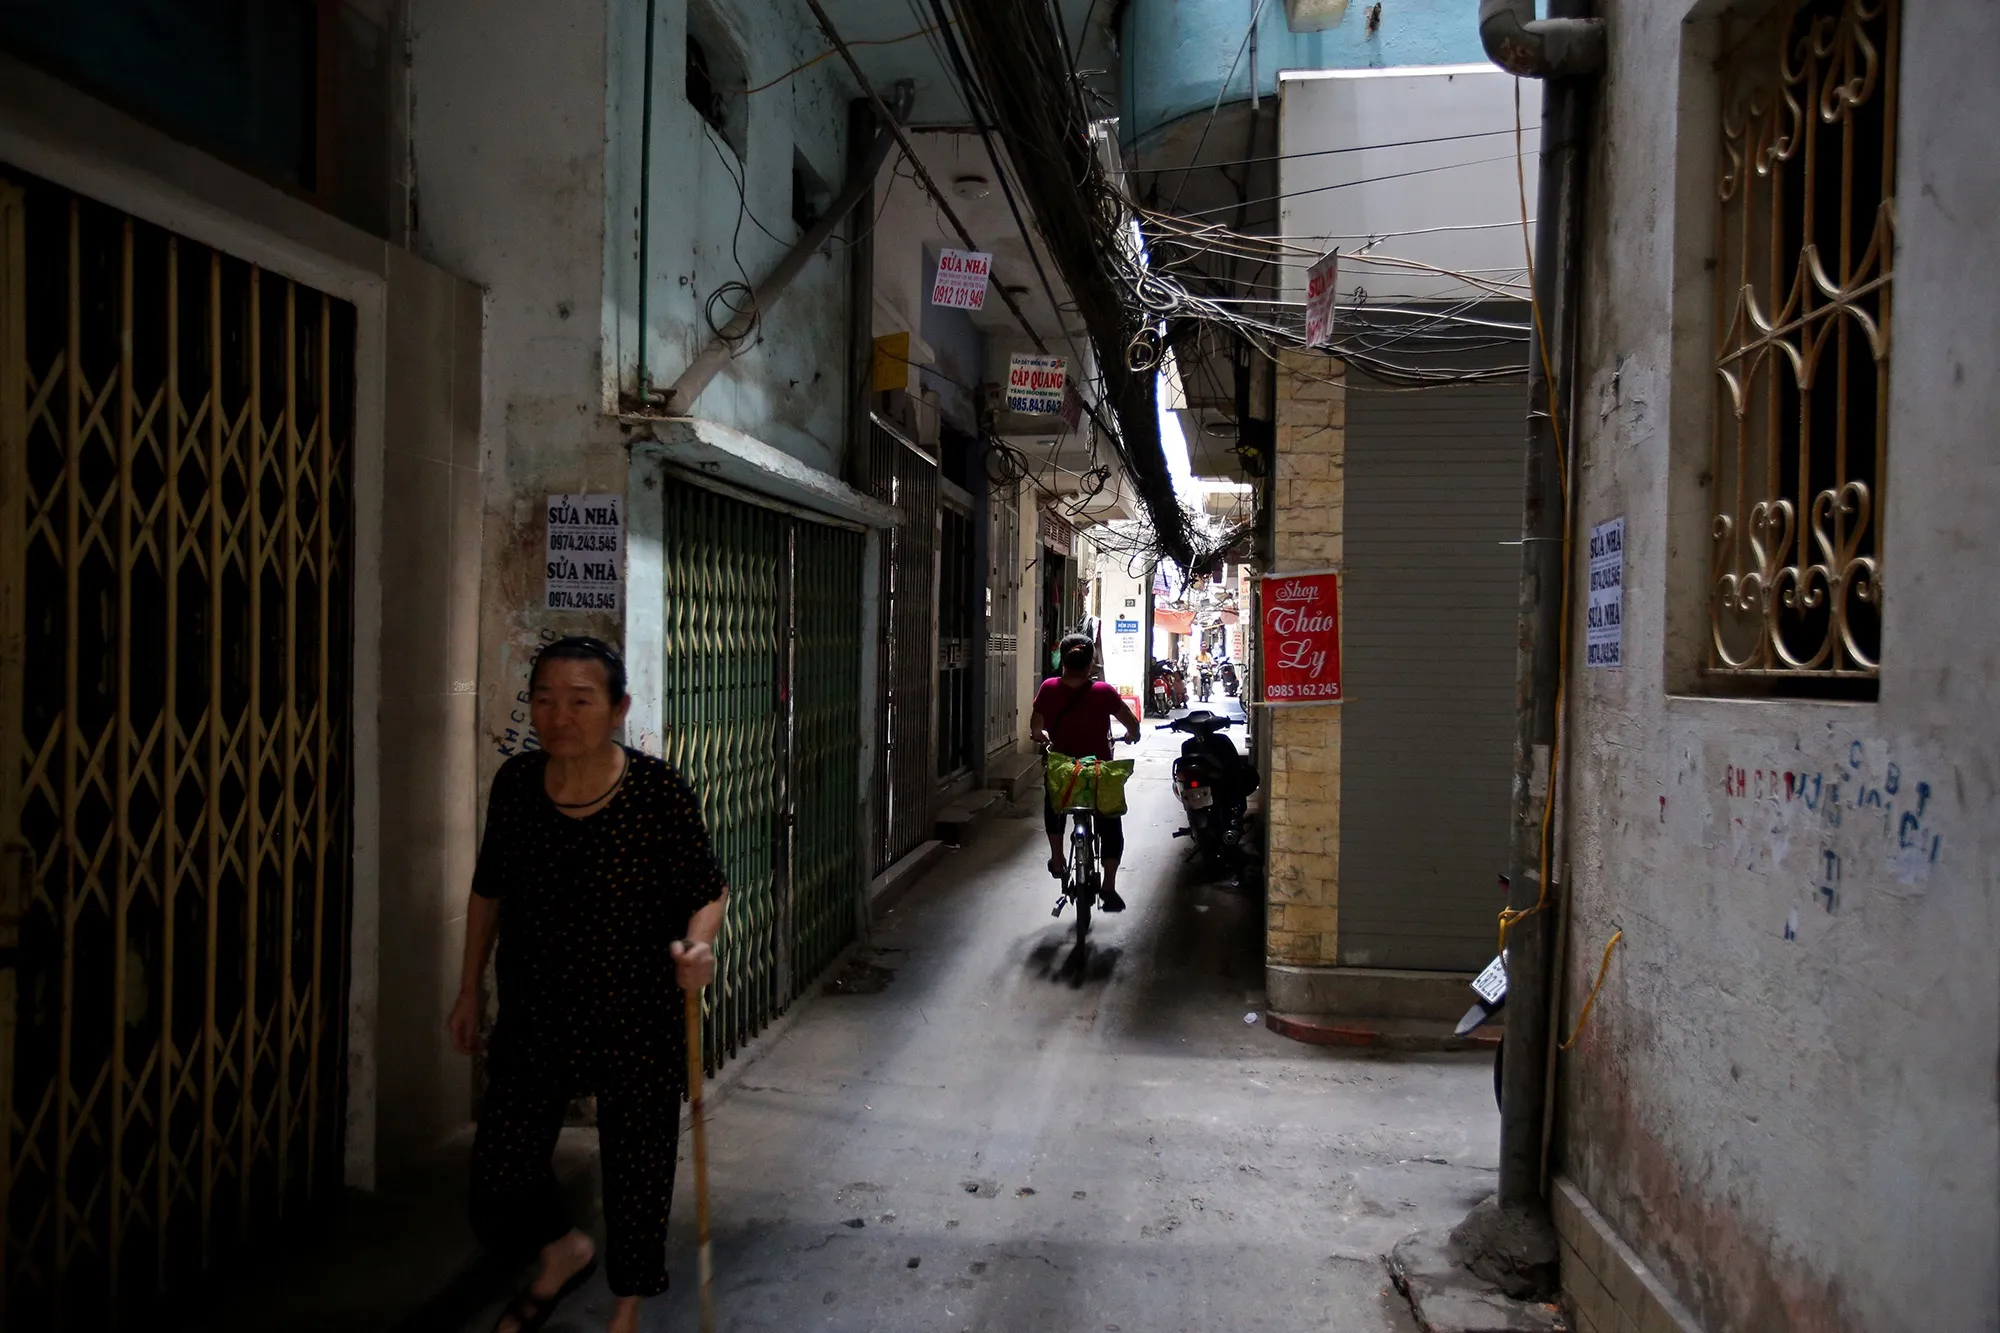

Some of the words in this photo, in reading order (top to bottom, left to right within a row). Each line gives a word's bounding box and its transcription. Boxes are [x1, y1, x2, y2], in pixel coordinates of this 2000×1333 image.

[940, 251, 962, 272] SỬA
[965, 257, 988, 275] NHÀ
[933, 285, 953, 303] 0912
[955, 288, 969, 305] 131
[969, 289, 984, 308] 949
[1011, 366, 1030, 386] CÁP
[1031, 371, 1063, 391] QUANG
[549, 495, 580, 524] SỬA
[585, 500, 619, 525] NHÀ
[550, 534, 617, 552] 0974.243.545
[1605, 523, 1621, 553] NHÀ
[547, 555, 579, 579] SỬA
[583, 559, 618, 580] NHÀ
[549, 591, 616, 609] 0974.243.545
[1276, 580, 1319, 602] Shop
[1267, 606, 1333, 636] Thảo
[1604, 596, 1621, 626] NHÀ
[1277, 639, 1326, 678] Ly
[1267, 684, 1294, 697] 0985
[1297, 683, 1316, 696] 162
[1318, 682, 1338, 695] 245
